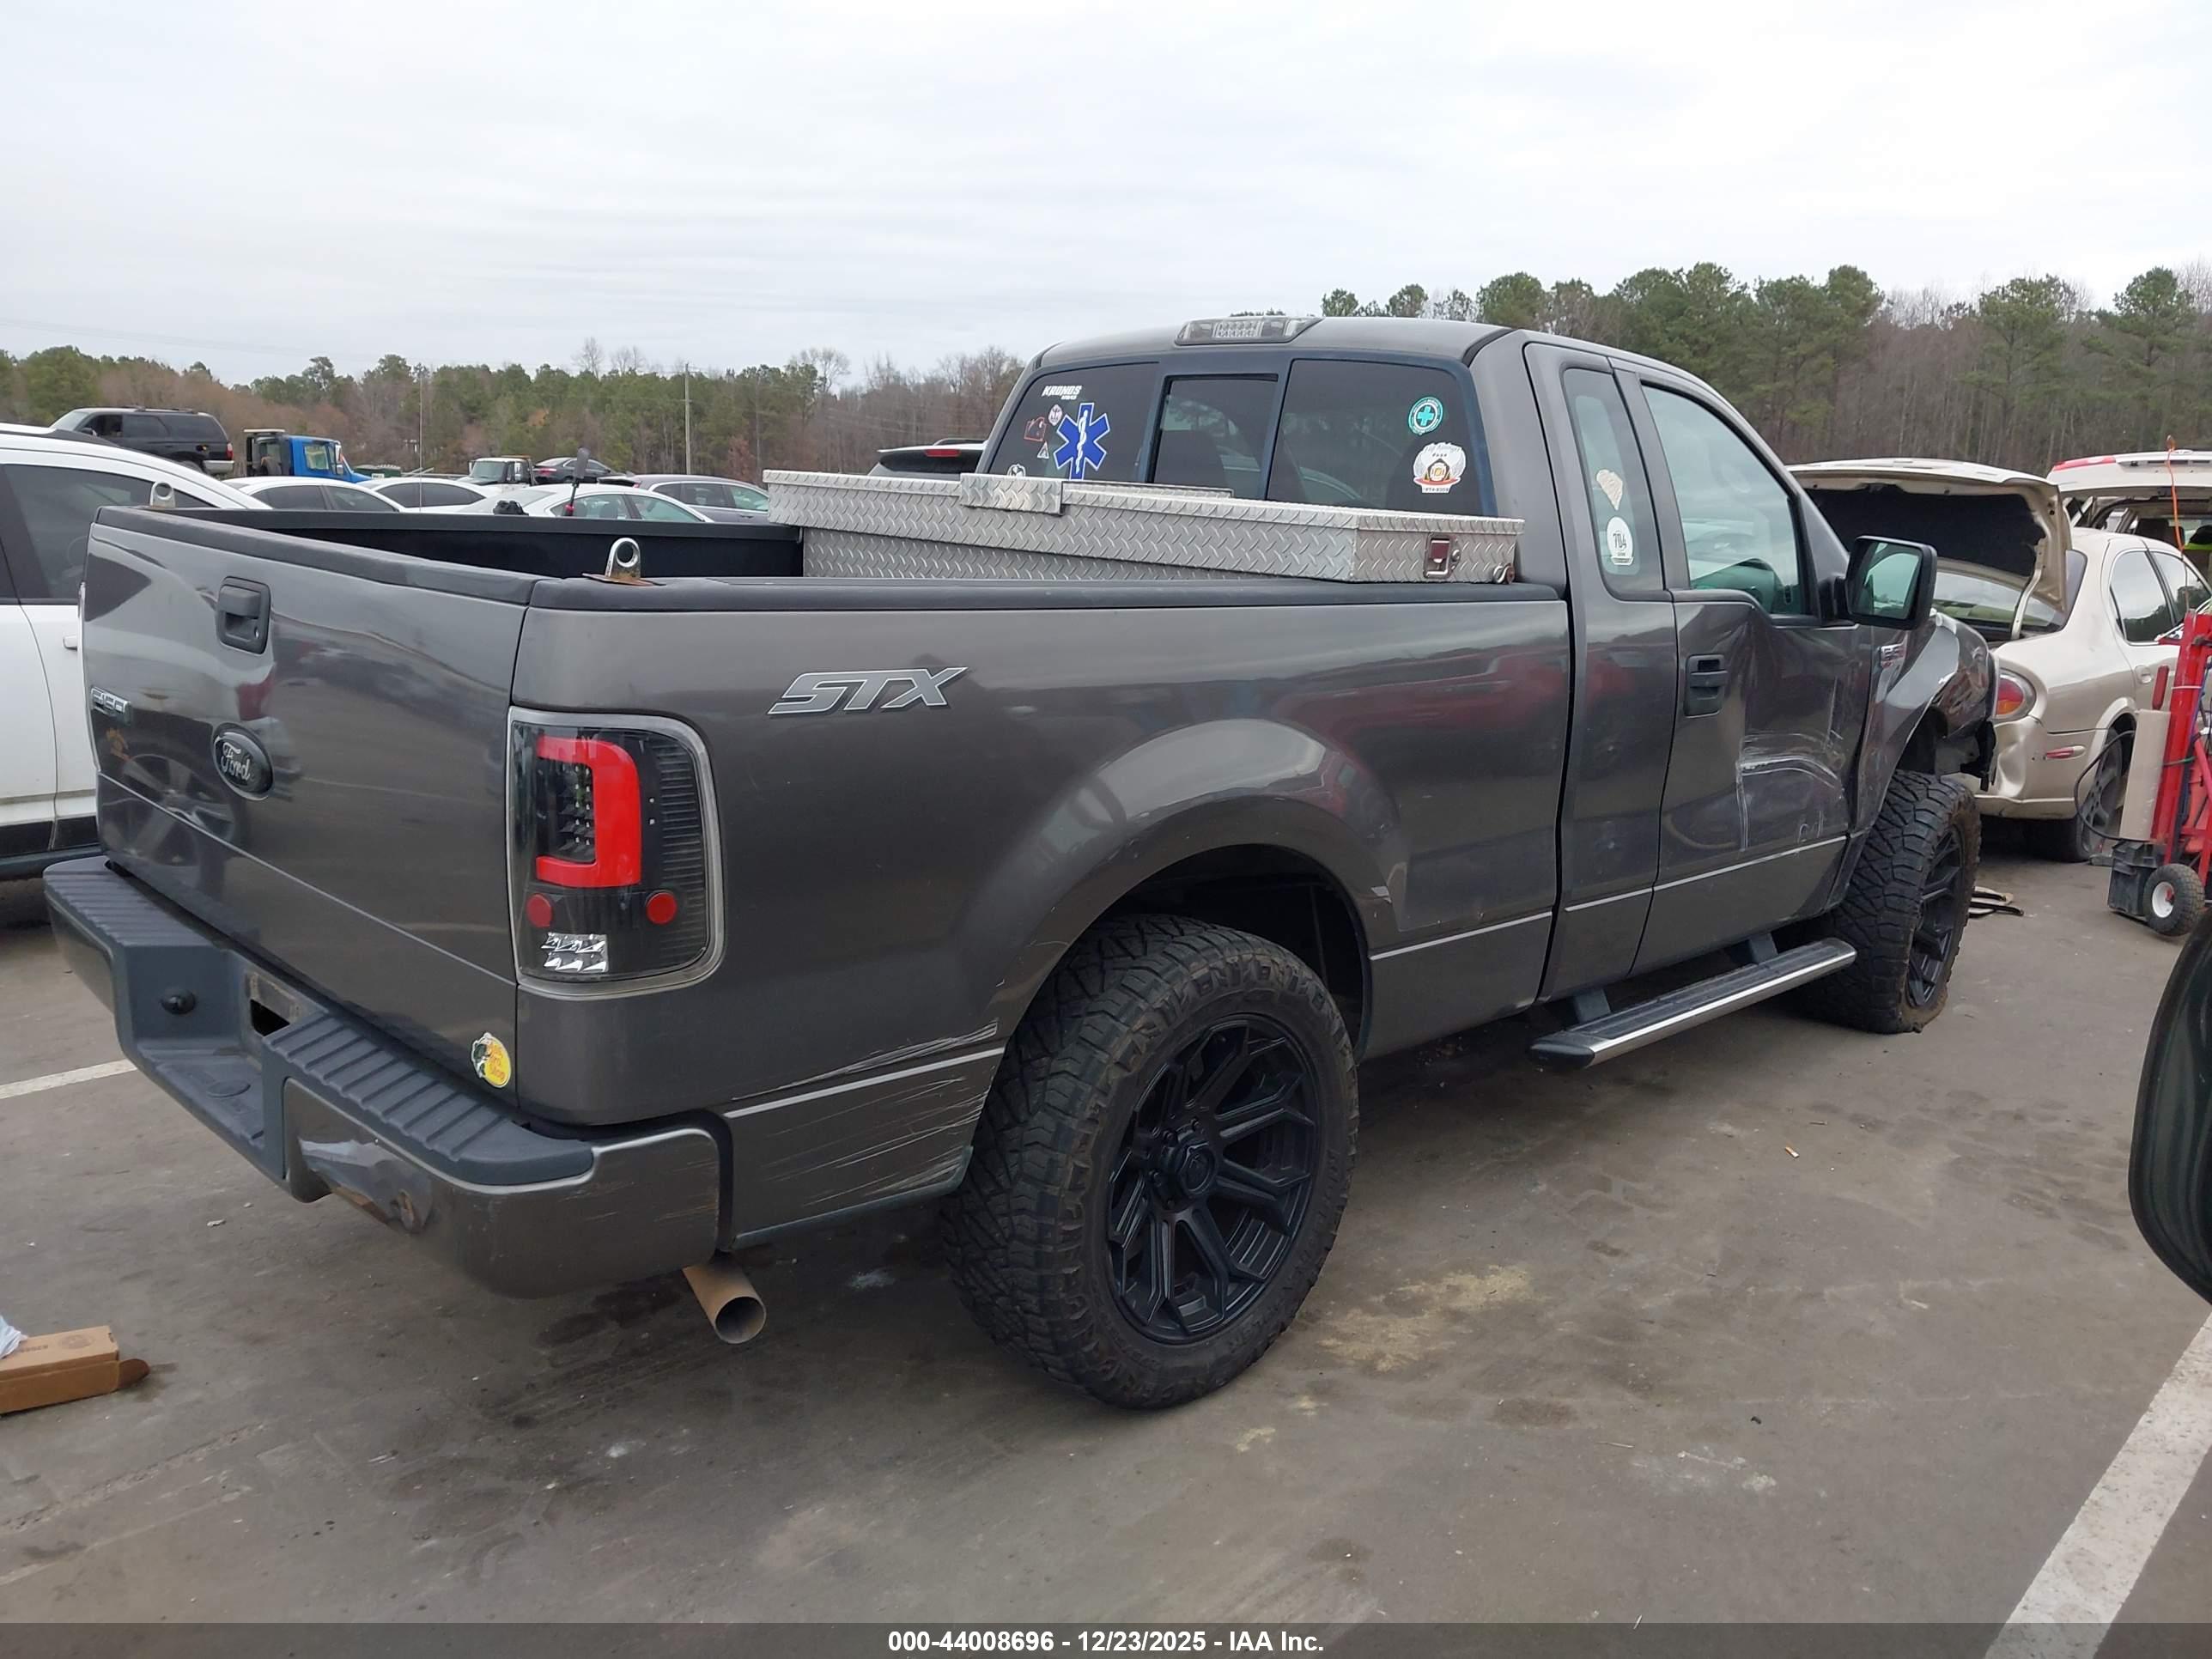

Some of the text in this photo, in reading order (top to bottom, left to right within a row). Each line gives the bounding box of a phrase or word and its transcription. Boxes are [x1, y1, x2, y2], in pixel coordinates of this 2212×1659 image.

[1042, 385, 1082, 397] KRONOS
[767, 666, 969, 716] STX
[220, 742, 252, 781] Ford
